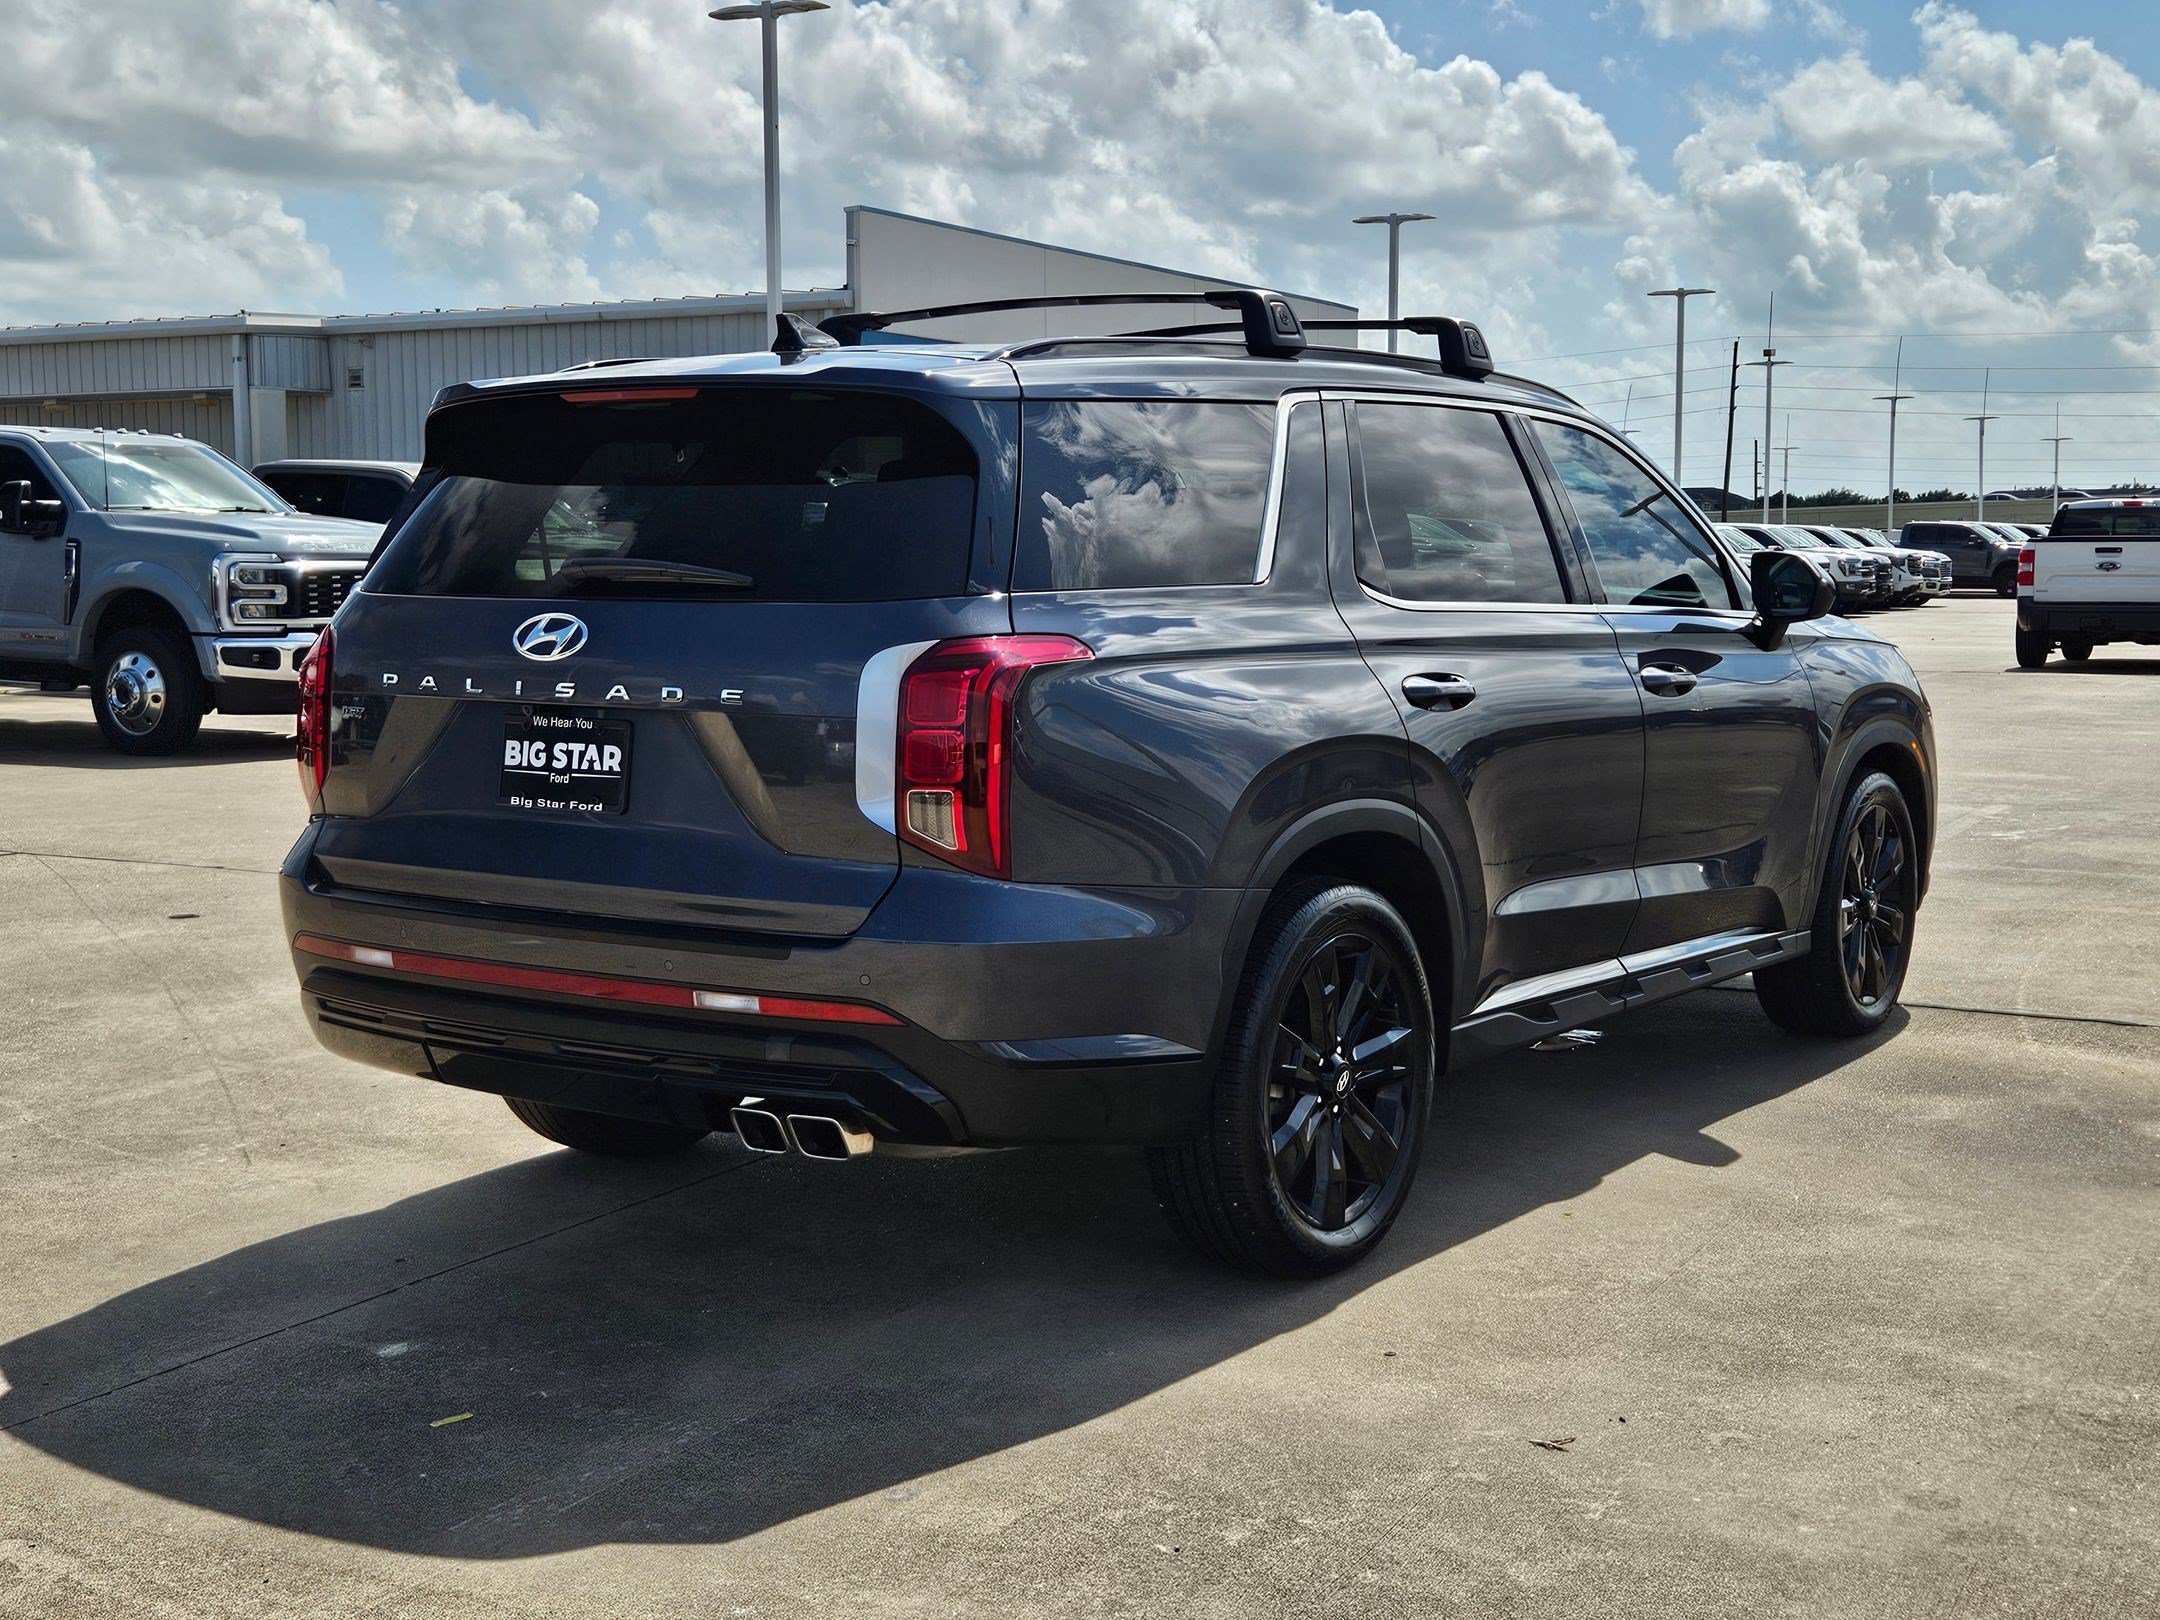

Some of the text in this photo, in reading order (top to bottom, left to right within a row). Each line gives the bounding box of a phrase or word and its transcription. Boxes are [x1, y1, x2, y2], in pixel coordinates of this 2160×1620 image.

[382, 673, 744, 705] PALISADE
[532, 715, 593, 729] We Hear You
[504, 739, 622, 772] BIG STAR
[549, 772, 570, 784] Ford
[510, 796, 603, 812] Big Star Ford
